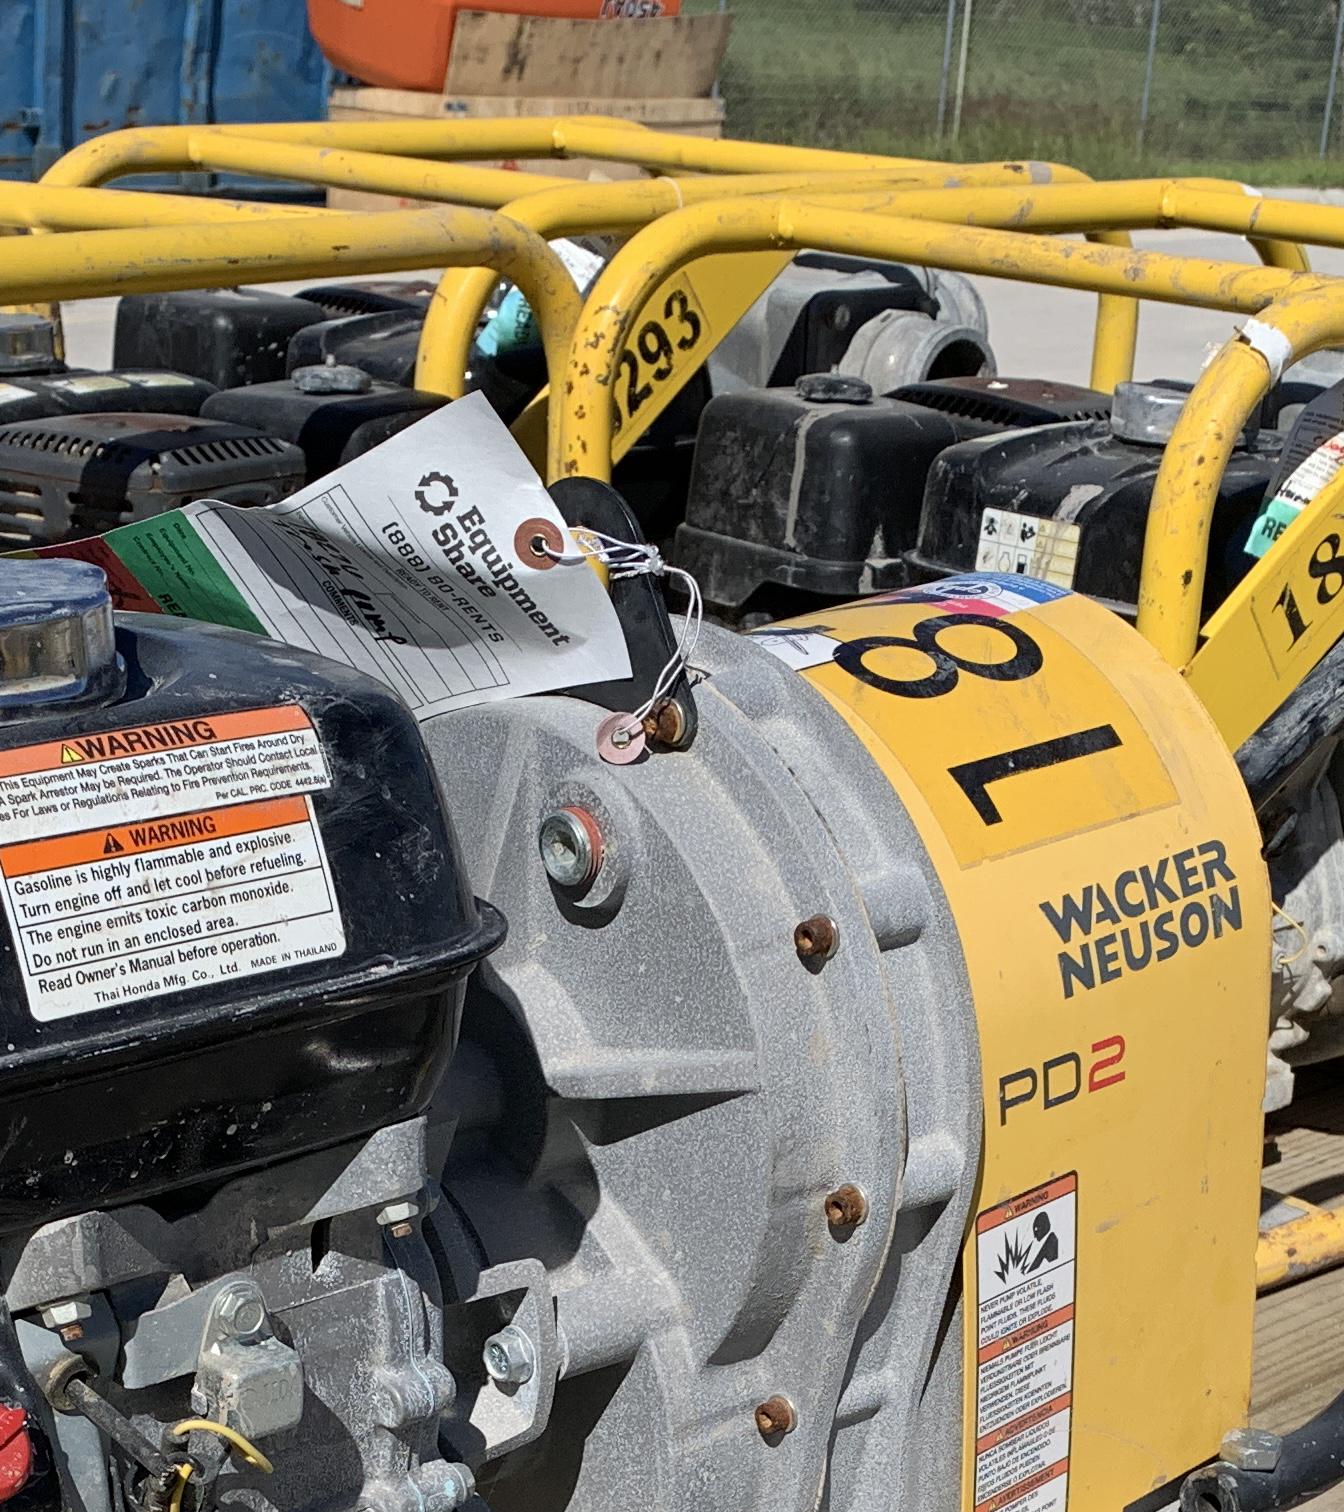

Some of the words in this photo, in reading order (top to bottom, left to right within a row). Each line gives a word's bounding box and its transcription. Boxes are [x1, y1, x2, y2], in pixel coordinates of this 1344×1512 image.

[613, 287, 703, 434] 293
[381, 520, 432, 578] (888)
[428, 571, 504, 646] 80-RENTS
[429, 520, 497, 602] Share
[454, 505, 572, 650] Equipment
[322, 579, 358, 627] COMMENTS
[20, 770, 75, 789] Equipment
[75, 767, 97, 779] May
[98, 761, 131, 774] Create
[131, 755, 166, 770] Sparks
[165, 751, 188, 763] That
[188, 749, 208, 759] Can
[208, 744, 232, 757] Start
[232, 742, 255, 752] Fires
[256, 735, 288, 749] Around
[288, 733, 304, 744] Dry
[79, 720, 217, 759] WARNING
[6, 790, 38, 806] Spark
[39, 785, 77, 800] Arrestor
[79, 781, 100, 793] May
[101, 778, 118, 790] be
[116, 769, 163, 789] Required.
[162, 767, 182, 778] The
[183, 761, 223, 776] Operator
[224, 753, 257, 770] Should
[257, 748, 293, 763] Contact
[292, 743, 317, 757] Local
[11, 807, 29, 819] For
[30, 804, 58, 816] Laws
[59, 801, 70, 811] or
[71, 788, 129, 809] Regulations
[129, 784, 170, 798] Relating
[169, 782, 181, 792] to
[181, 778, 200, 790] Fire
[200, 769, 249, 786] Prevention
[249, 760, 312, 778] Requirements.
[13, 874, 72, 895] Gasoline
[74, 869, 88, 884] is
[89, 861, 130, 881] highly
[133, 847, 204, 872] flammable
[208, 840, 232, 858] and
[235, 831, 295, 853] explosive.
[128, 815, 216, 847] WARNING
[18, 902, 51, 918] Turn
[54, 892, 100, 912] engine
[104, 884, 122, 902] off
[126, 878, 151, 897] and
[153, 876, 172, 892] let
[174, 869, 202, 888] cool
[204, 864, 246, 886] before
[249, 852, 306, 873] refueling.
[25, 929, 52, 945] The
[56, 919, 102, 939] engine
[105, 910, 142, 929] emits
[144, 902, 178, 920] toxic
[181, 891, 226, 913] carbon
[229, 880, 293, 904] monoxide.
[1039, 839, 1237, 944] WACKER
[32, 953, 52, 968] Do
[55, 946, 78, 963] not
[80, 943, 104, 958] run
[106, 937, 120, 952] in
[123, 935, 140, 949] an
[144, 919, 202, 944] enclosed
[205, 916, 238, 931] area.
[37, 972, 72, 993] Read
[75, 961, 126, 985] Owner's
[128, 950, 175, 973] Manual
[176, 944, 217, 962] before
[220, 931, 280, 955] operation.
[93, 987, 120, 1002] Thai
[121, 979, 160, 997] Honda
[162, 973, 189, 987] Mfg.
[191, 969, 214, 981] Co.,
[219, 961, 240, 975] Ltd.
[250, 955, 277, 968] MADE
[280, 952, 291, 961] IN
[293, 942, 337, 958] THAILAND
[1057, 885, 1244, 1000] NEUSON
[998, 1034, 1127, 1127] PD2
